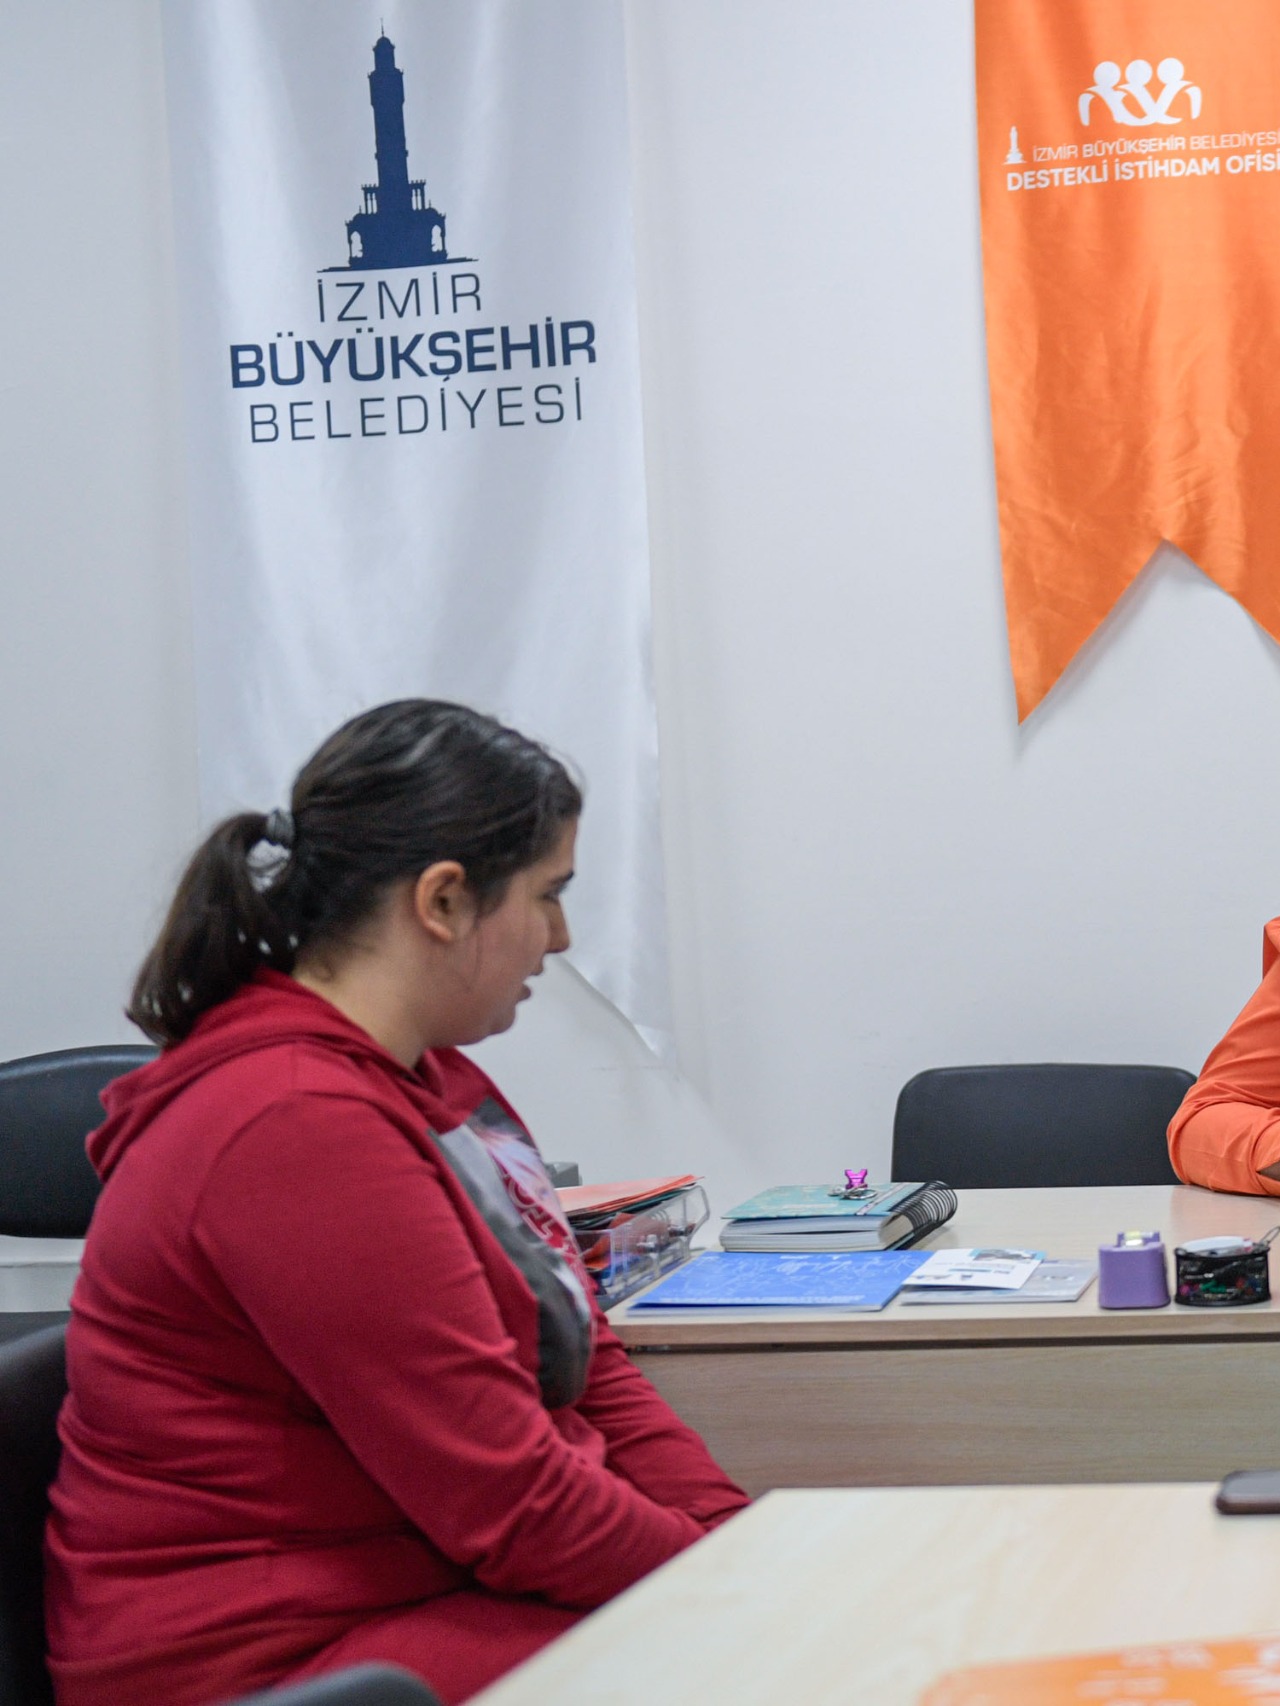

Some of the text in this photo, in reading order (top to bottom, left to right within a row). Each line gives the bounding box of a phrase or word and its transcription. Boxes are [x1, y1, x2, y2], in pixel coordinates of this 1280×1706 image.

[1007, 159, 1108, 191] DESTEKLİ
[1115, 156, 1220, 181] İSTİHDAM
[1033, 144, 1078, 162] İZMİR
[1082, 136, 1185, 157] BÜYÜKŞEHİR
[318, 271, 481, 323] İZMİR
[230, 316, 596, 388] BÜYÜKŞEHİR
[249, 377, 582, 443] BELEDİYESİ
